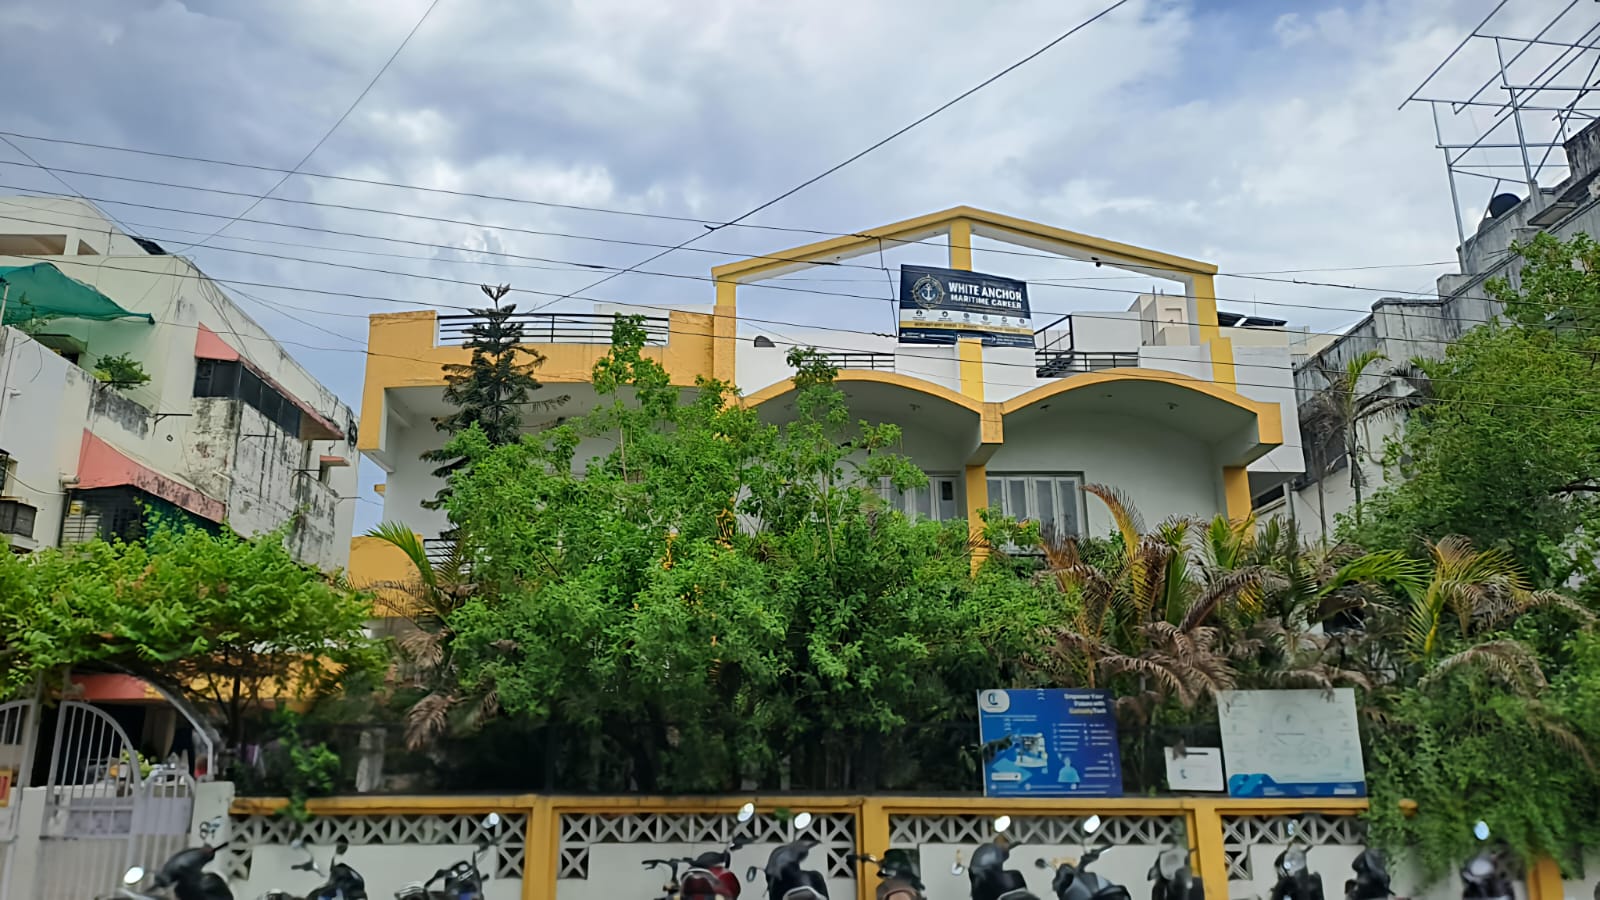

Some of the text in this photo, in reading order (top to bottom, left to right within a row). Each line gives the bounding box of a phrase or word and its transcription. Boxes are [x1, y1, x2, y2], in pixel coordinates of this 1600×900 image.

[948, 282, 1022, 301] WHITE ANCHOR
[950, 294, 1022, 309] MARITIME CAREER
